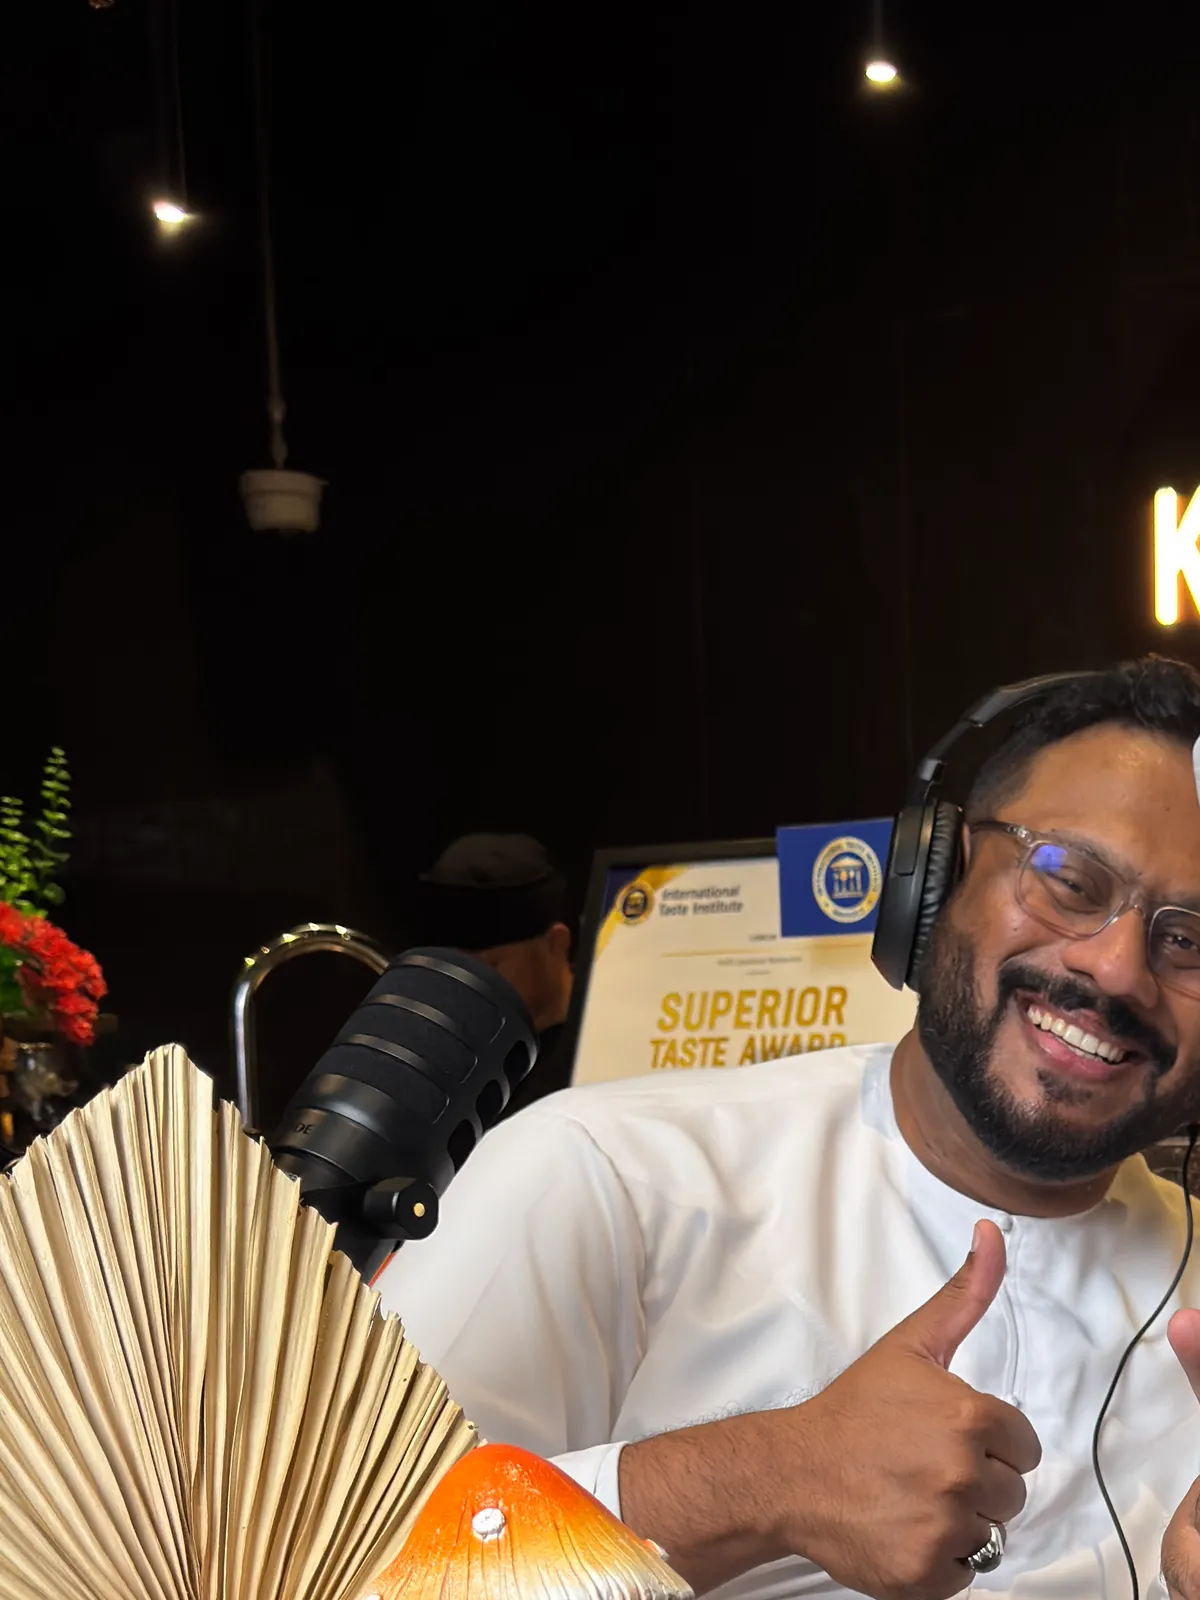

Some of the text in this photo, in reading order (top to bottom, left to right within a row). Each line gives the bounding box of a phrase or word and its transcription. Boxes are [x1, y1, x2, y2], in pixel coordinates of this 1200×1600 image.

[662, 885, 741, 900] International
[659, 900, 745, 917] Taste Institute
[657, 986, 848, 1032] SUPERIOR
[649, 1035, 730, 1069] TASTE
